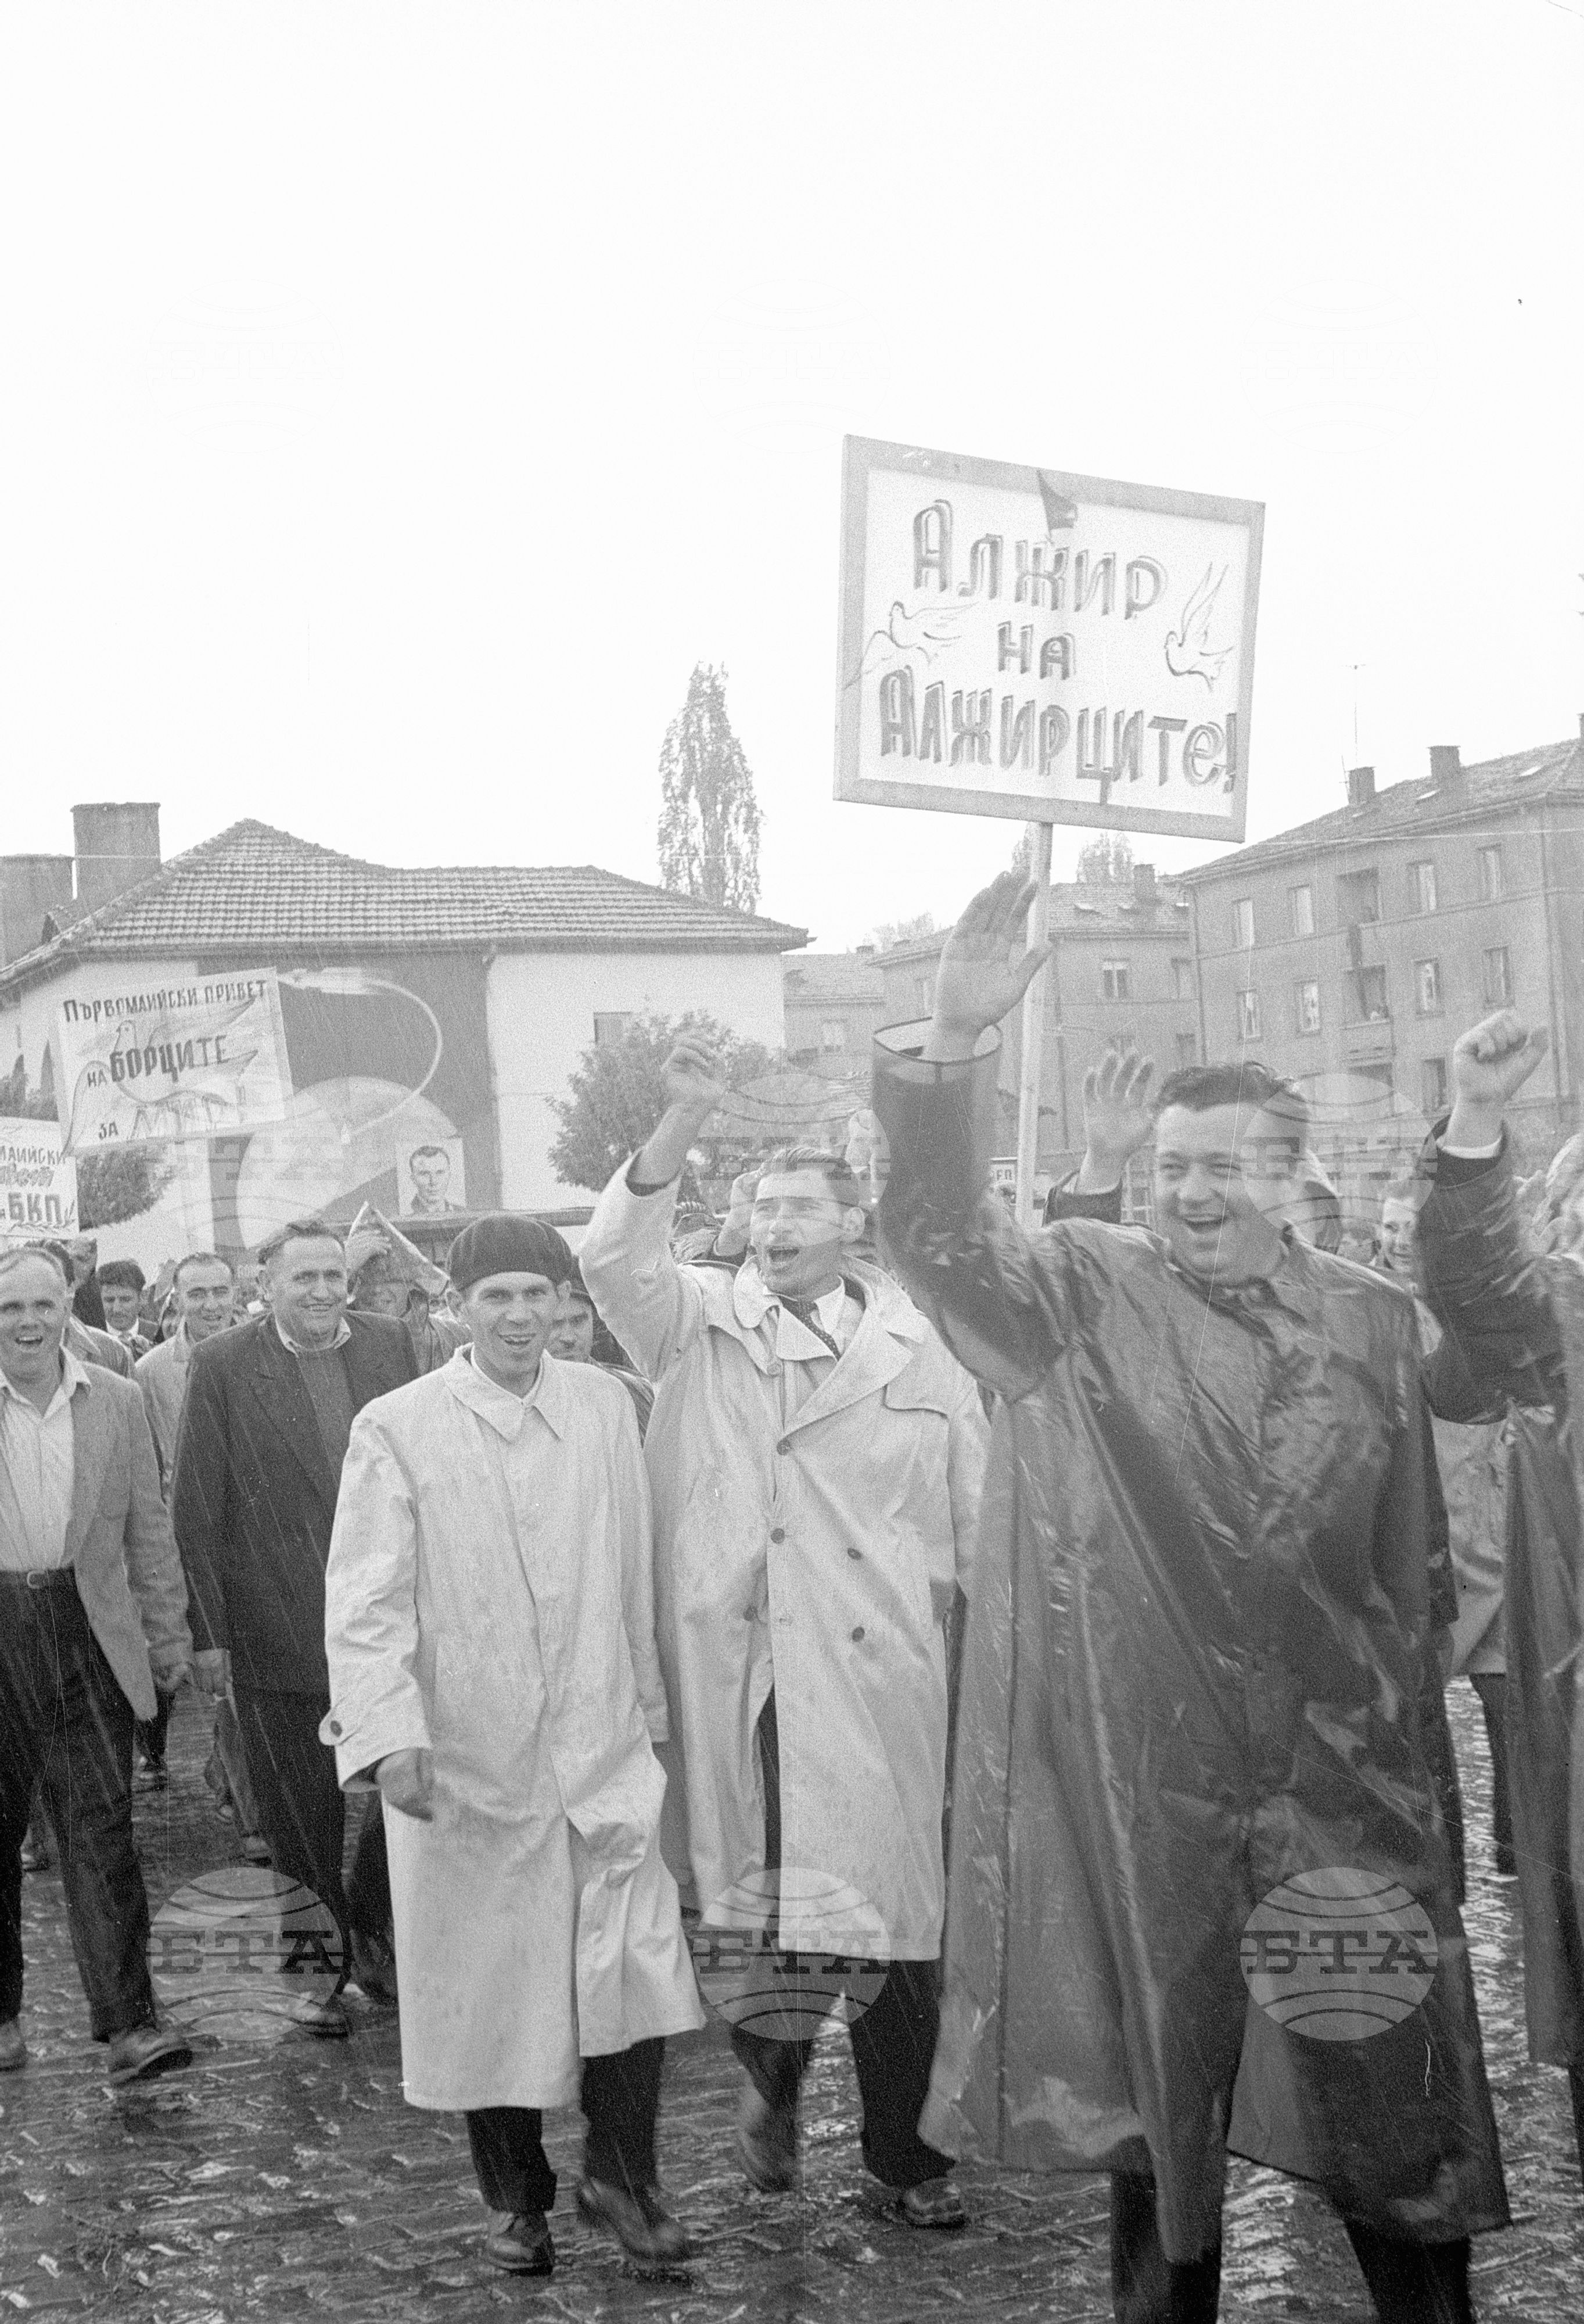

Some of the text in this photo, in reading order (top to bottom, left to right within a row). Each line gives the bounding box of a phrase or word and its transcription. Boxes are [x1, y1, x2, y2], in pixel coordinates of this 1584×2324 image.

[913, 498, 1168, 621] АЛЖИР
[997, 621, 1077, 680] НА
[204, 979, 268, 1004] ПРИВЕТ
[87, 1034, 228, 1088] НА БОРЦИТЕ
[98, 1121, 119, 1140] ЗА
[8, 1192, 62, 1224] БКП
